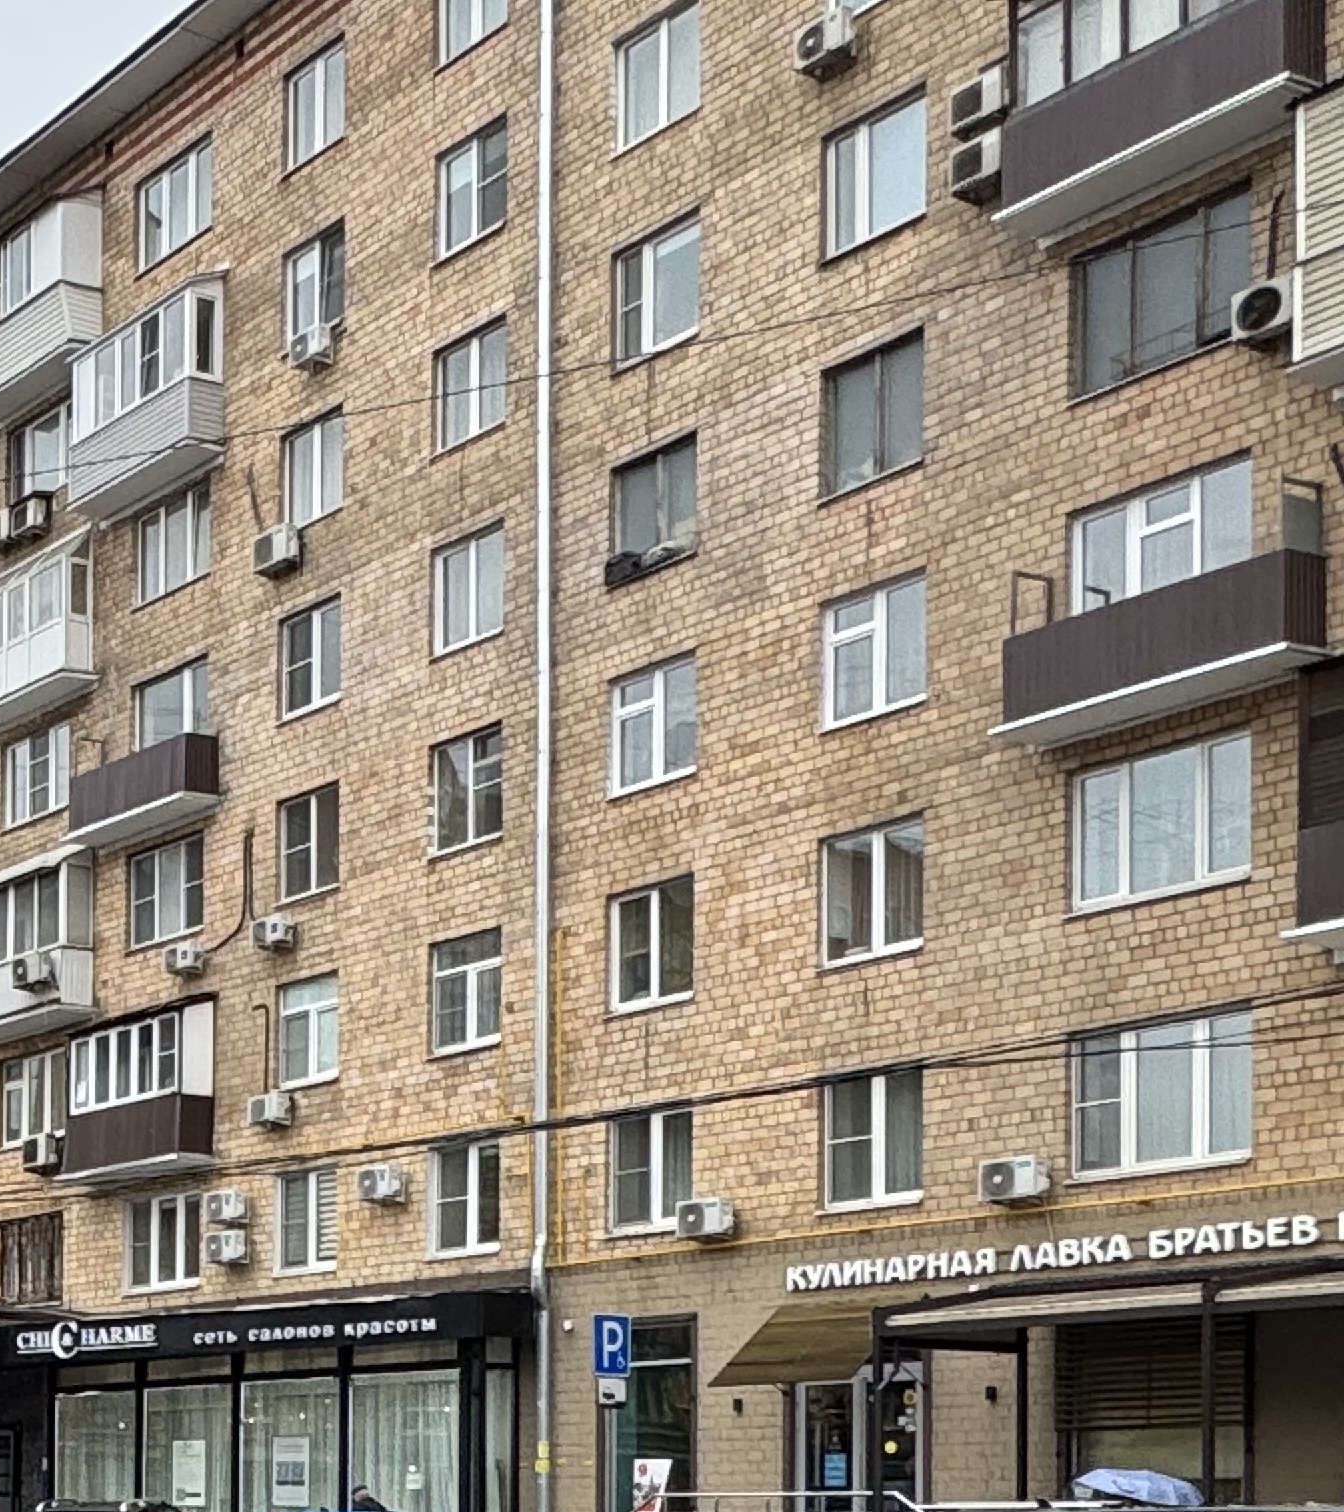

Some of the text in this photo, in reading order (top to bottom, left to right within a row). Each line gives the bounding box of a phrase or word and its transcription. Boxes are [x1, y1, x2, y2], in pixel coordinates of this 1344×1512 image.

[786, 1247, 996, 1292] КУЛИНАРНАЯ
[1009, 1234, 1131, 1272] ЛАВКА
[1148, 1214, 1320, 1260] БРАТЬЕВ
[192, 1317, 437, 1345] сеть салонов красоты
[602, 1320, 624, 1368] P
